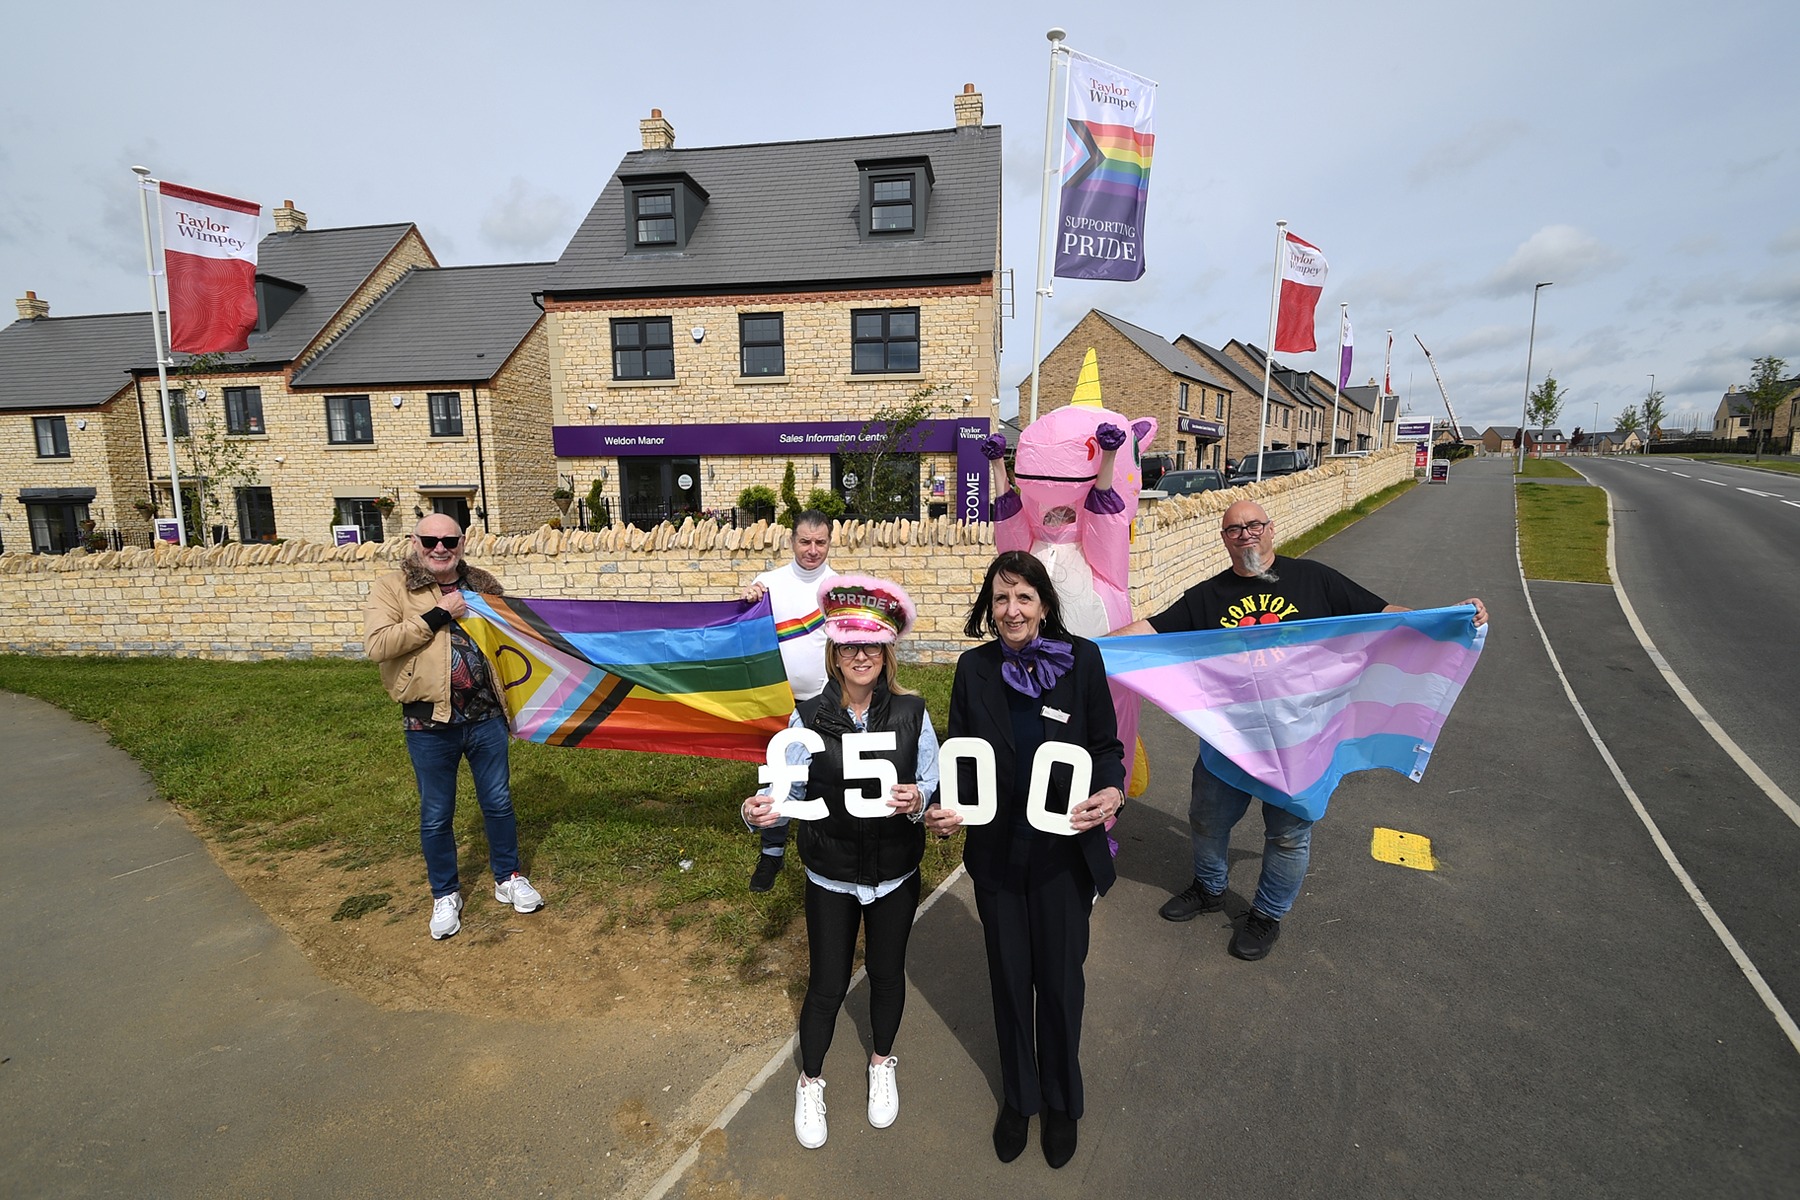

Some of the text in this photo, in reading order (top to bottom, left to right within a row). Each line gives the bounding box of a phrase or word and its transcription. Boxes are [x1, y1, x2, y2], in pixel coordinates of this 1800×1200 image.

[1090, 77, 1130, 97] Taylor
[176, 211, 230, 233] Taylor
[1065, 215, 1136, 238] SUPPORTING
[177, 223, 246, 251] Wimpey
[1062, 232, 1137, 262] PRIDE
[604, 436, 665, 446] Weldon Manor
[779, 434, 804, 443] Sales
[805, 432, 857, 443] Information
[960, 432, 988, 441] Wimpey
[837, 593, 888, 611] PRIDE
[1220, 593, 1299, 629] CONVOY
